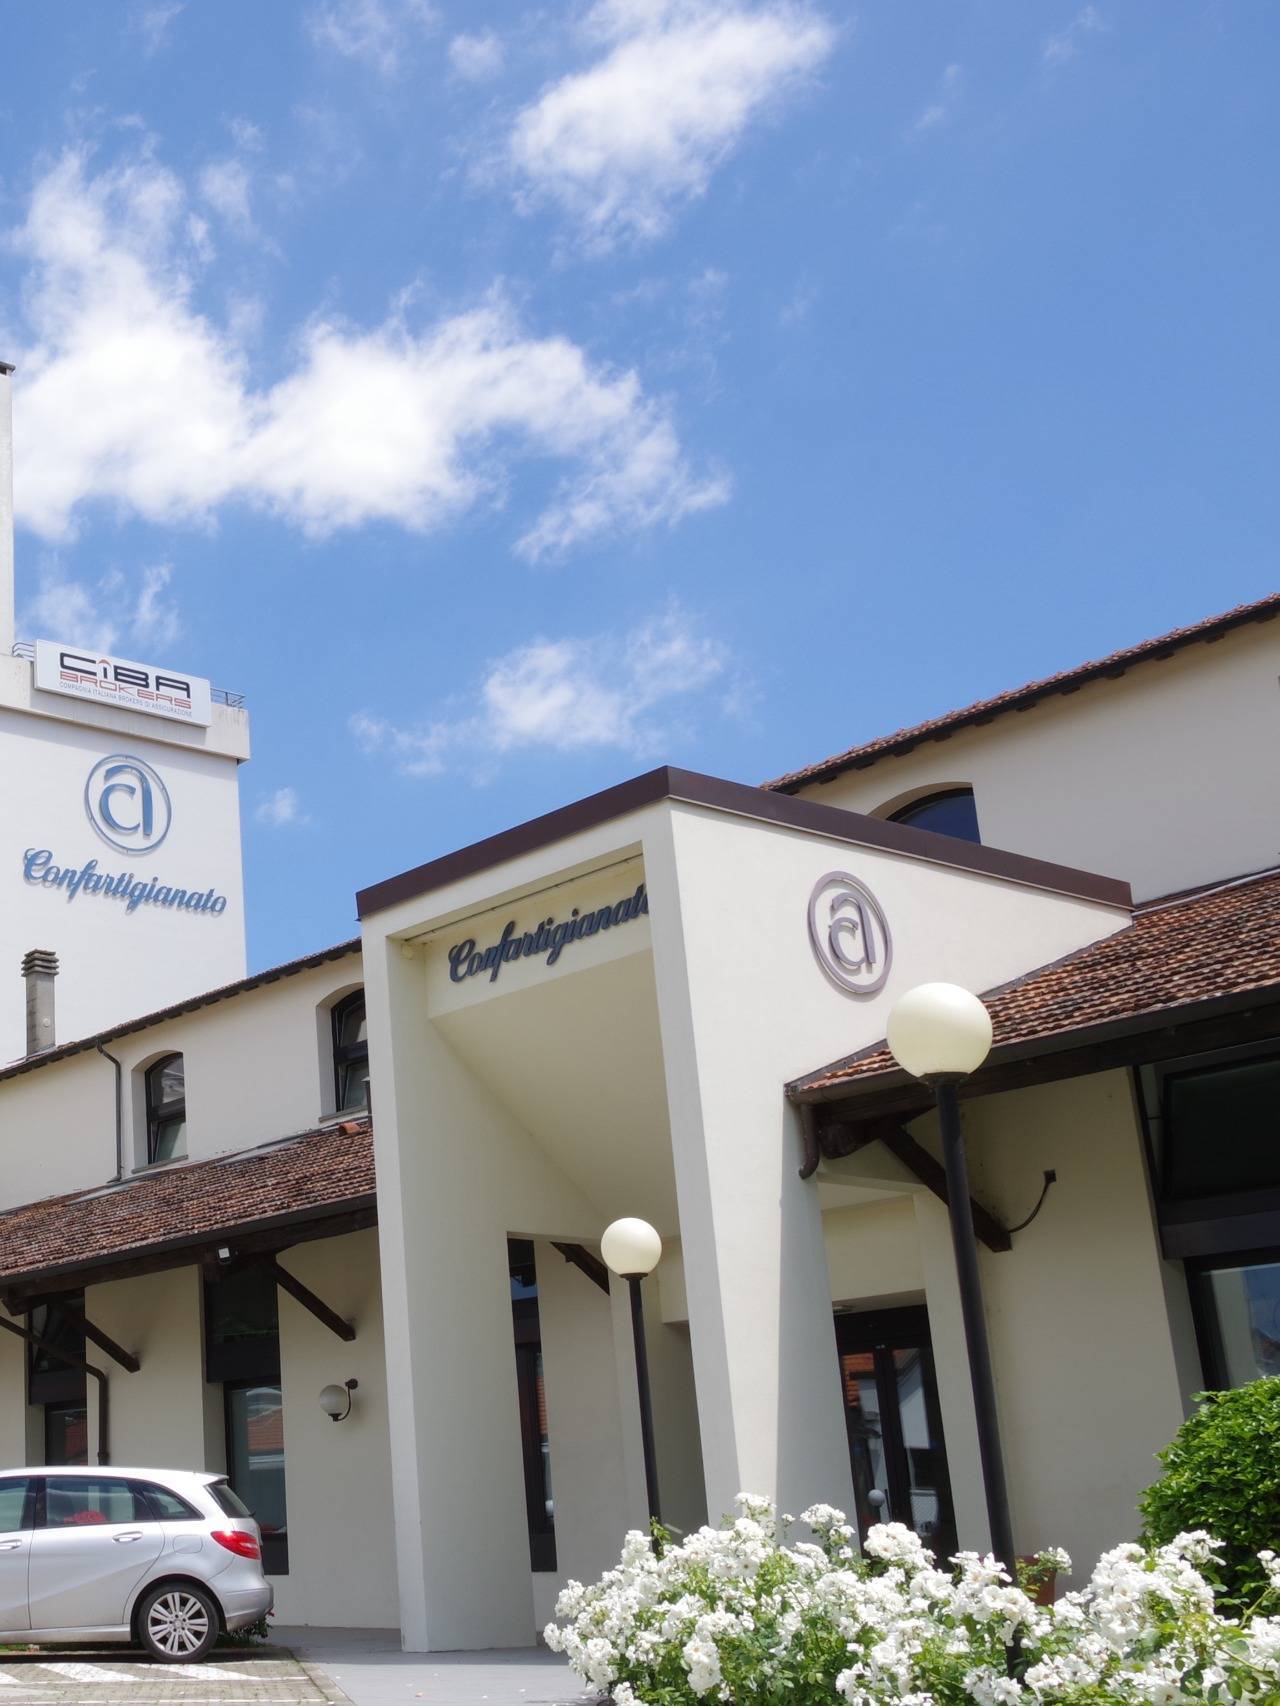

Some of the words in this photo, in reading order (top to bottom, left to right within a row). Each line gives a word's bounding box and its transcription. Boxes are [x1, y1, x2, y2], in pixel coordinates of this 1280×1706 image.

[59, 681, 91, 695] COMPAGNIA
[93, 688, 117, 699] ITALIANA
[118, 694, 144, 706] BROKERS
[60, 670, 192, 709] BROKERS
[23, 848, 227, 916] Confartigianato
